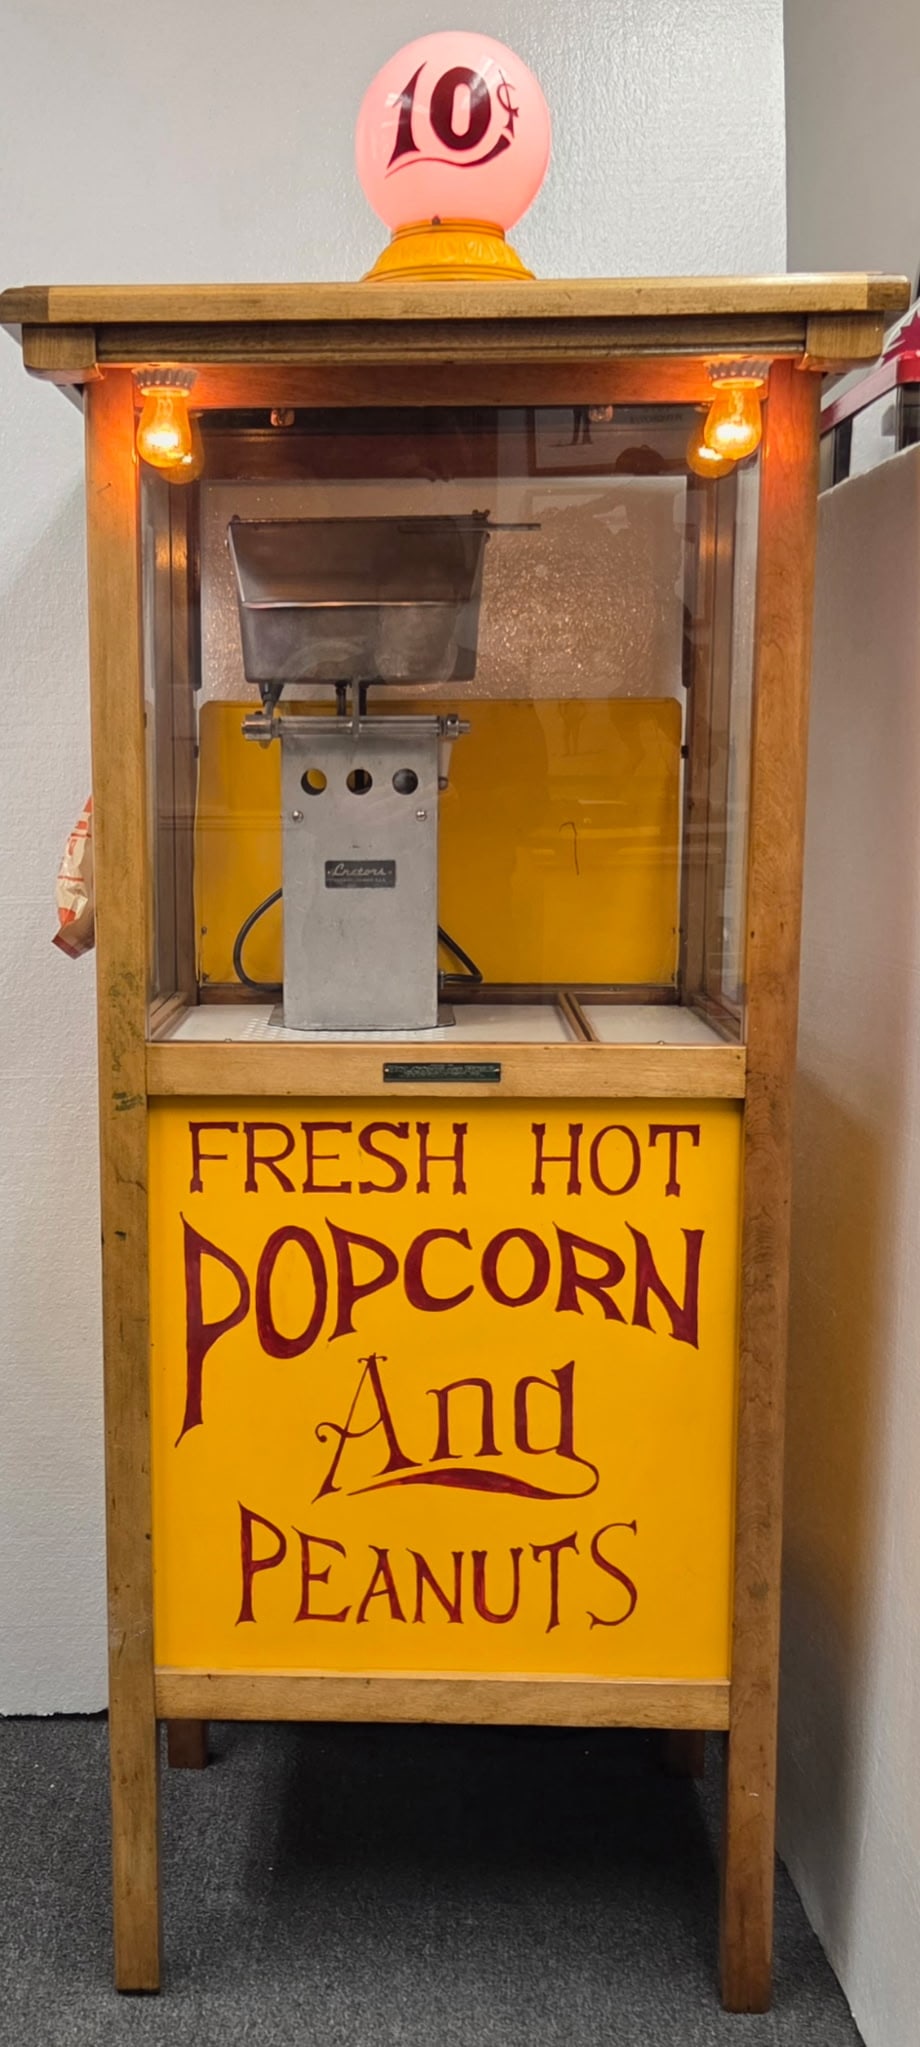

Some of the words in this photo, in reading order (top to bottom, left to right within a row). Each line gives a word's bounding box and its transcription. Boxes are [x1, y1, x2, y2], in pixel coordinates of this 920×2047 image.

[387, 60, 520, 170] 10¢
[188, 1120, 468, 1195] FRESH
[531, 1122, 701, 1198] HOT
[174, 1211, 705, 1449] POPCORN
[311, 1352, 600, 1504] And
[234, 1501, 638, 1634] PEANUTS
